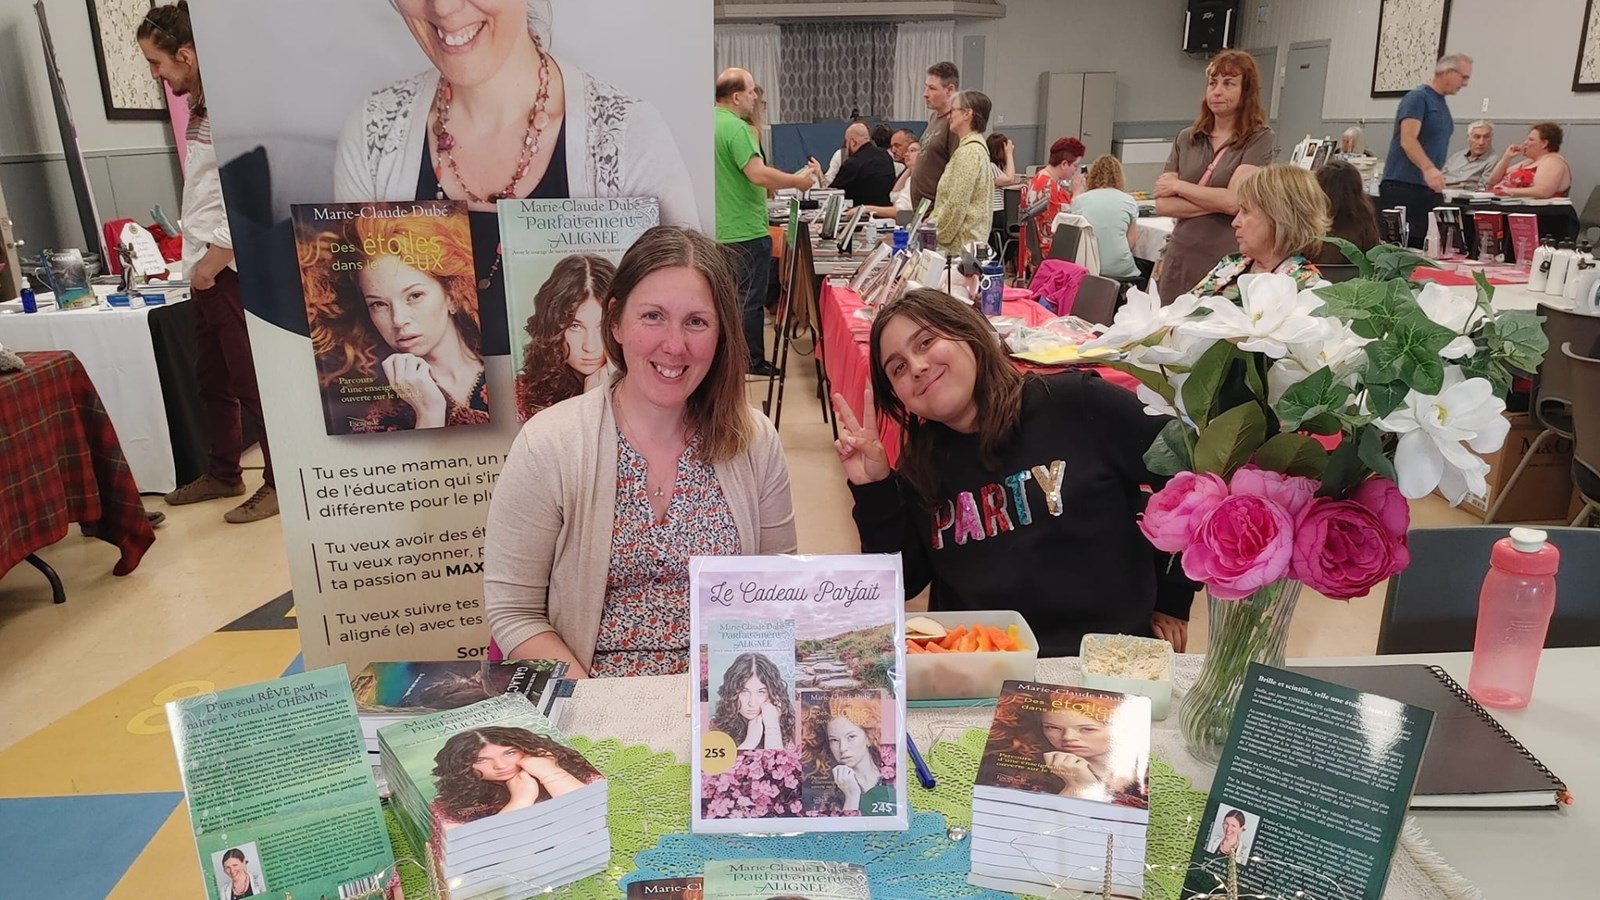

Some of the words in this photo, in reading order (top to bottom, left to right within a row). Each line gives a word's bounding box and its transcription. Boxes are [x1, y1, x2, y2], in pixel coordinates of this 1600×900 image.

[314, 206, 408, 220] Marie-Claude
[412, 204, 449, 218] Dubé
[520, 199, 604, 213] Marie-Claude
[609, 199, 640, 211] Dubé
[517, 214, 644, 230] Parfaitement
[330, 242, 356, 253] Des
[363, 230, 441, 256] étoiles
[548, 230, 619, 249] ALIGNÉE
[332, 260, 363, 271] dans
[339, 377, 374, 385] Parcours
[340, 385, 363, 394] d'une
[341, 394, 372, 403] ouverte
[312, 467, 334, 480] Tu
[339, 467, 358, 478] es
[363, 464, 396, 476] une
[402, 456, 472, 473] maman,
[476, 454, 498, 465] un
[317, 486, 339, 499] de
[344, 478, 439, 497] l'éducation
[444, 473, 471, 489] qui
[319, 501, 405, 518] différente
[410, 496, 448, 513] pour
[454, 493, 468, 505] le
[931, 460, 1066, 550] PARTY
[324, 542, 345, 554] Tu
[350, 538, 390, 551] veux
[395, 532, 434, 546] avoir
[438, 529, 468, 543] des
[327, 560, 348, 573] Tu
[353, 557, 393, 570] veux
[398, 548, 473, 566] rayonner,
[331, 579, 348, 590] ta
[354, 570, 416, 591] passion
[421, 569, 441, 580] au
[446, 561, 485, 577] MAX
[710, 581, 735, 607] Le
[739, 581, 808, 604] Cadeau
[813, 580, 880, 608] Parfait
[336, 613, 356, 625] Tu
[361, 608, 400, 622] veux
[404, 602, 452, 617] suivre
[456, 598, 480, 610] tes
[339, 625, 391, 643] aligné
[395, 622, 415, 637] (e)
[419, 618, 456, 632] avec
[459, 613, 483, 626] tes
[206, 701, 233, 713] D'un
[235, 694, 256, 707] seul
[257, 686, 292, 702] RÊVE
[293, 682, 316, 697] peut
[1018, 684, 1095, 699] Marie-Claude
[1258, 674, 1277, 687] Brille
[1277, 680, 1286, 689] et
[1285, 682, 1314, 697] scintille,
[1314, 689, 1330, 701] telle
[1330, 694, 1344, 703] une
[219, 713, 229, 724] le
[231, 702, 275, 720] véritable
[1021, 704, 1047, 712] dans
[1024, 697, 1045, 705] Des
[1051, 699, 1114, 714] étoile
[704, 748, 726, 759] 25$
[871, 802, 893, 813] 24$
[730, 863, 813, 873] Marie-Claude
[644, 883, 704, 895] Marie-Cl
[753, 881, 829, 893] ALIGNÉE
